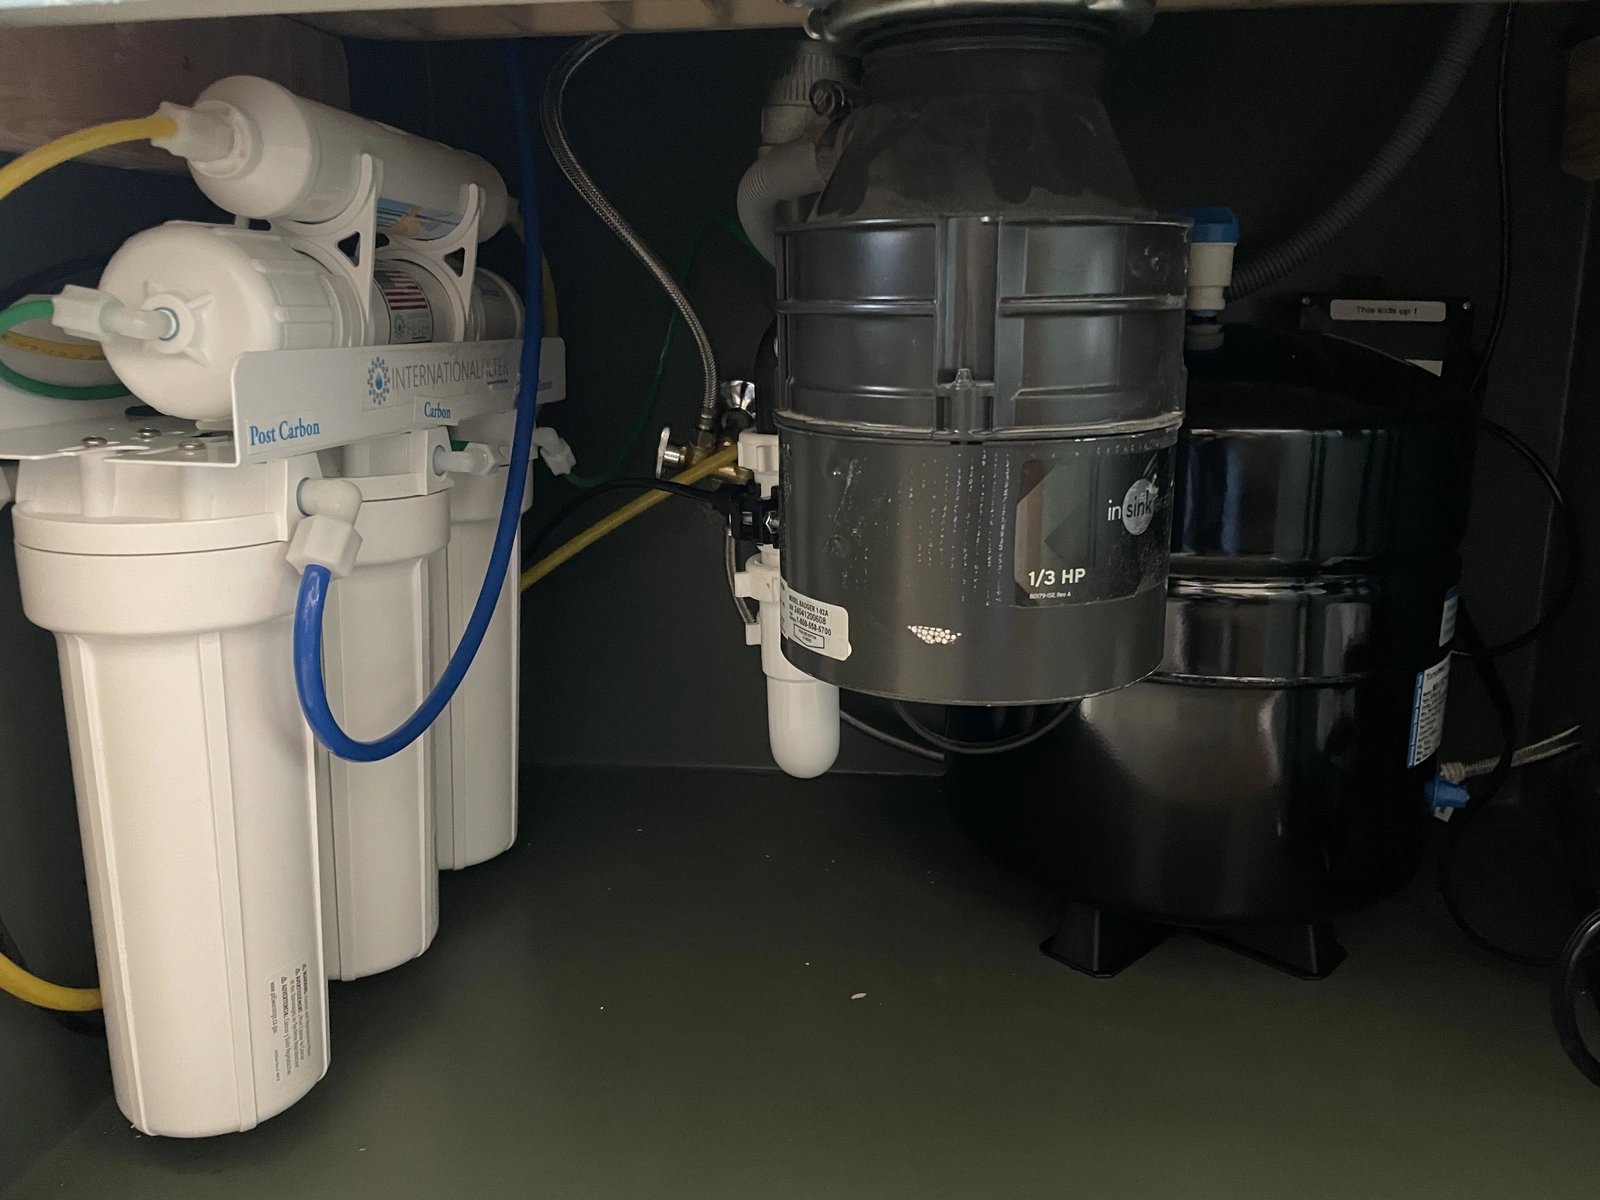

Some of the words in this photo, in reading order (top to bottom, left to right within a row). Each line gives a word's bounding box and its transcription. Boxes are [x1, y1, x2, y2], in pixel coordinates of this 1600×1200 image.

[424, 401, 451, 419] Carbon
[250, 425, 276, 446] Post
[279, 417, 320, 441] Carbon
[1028, 569, 1056, 588] 1/3
[1061, 568, 1086, 584] HP
